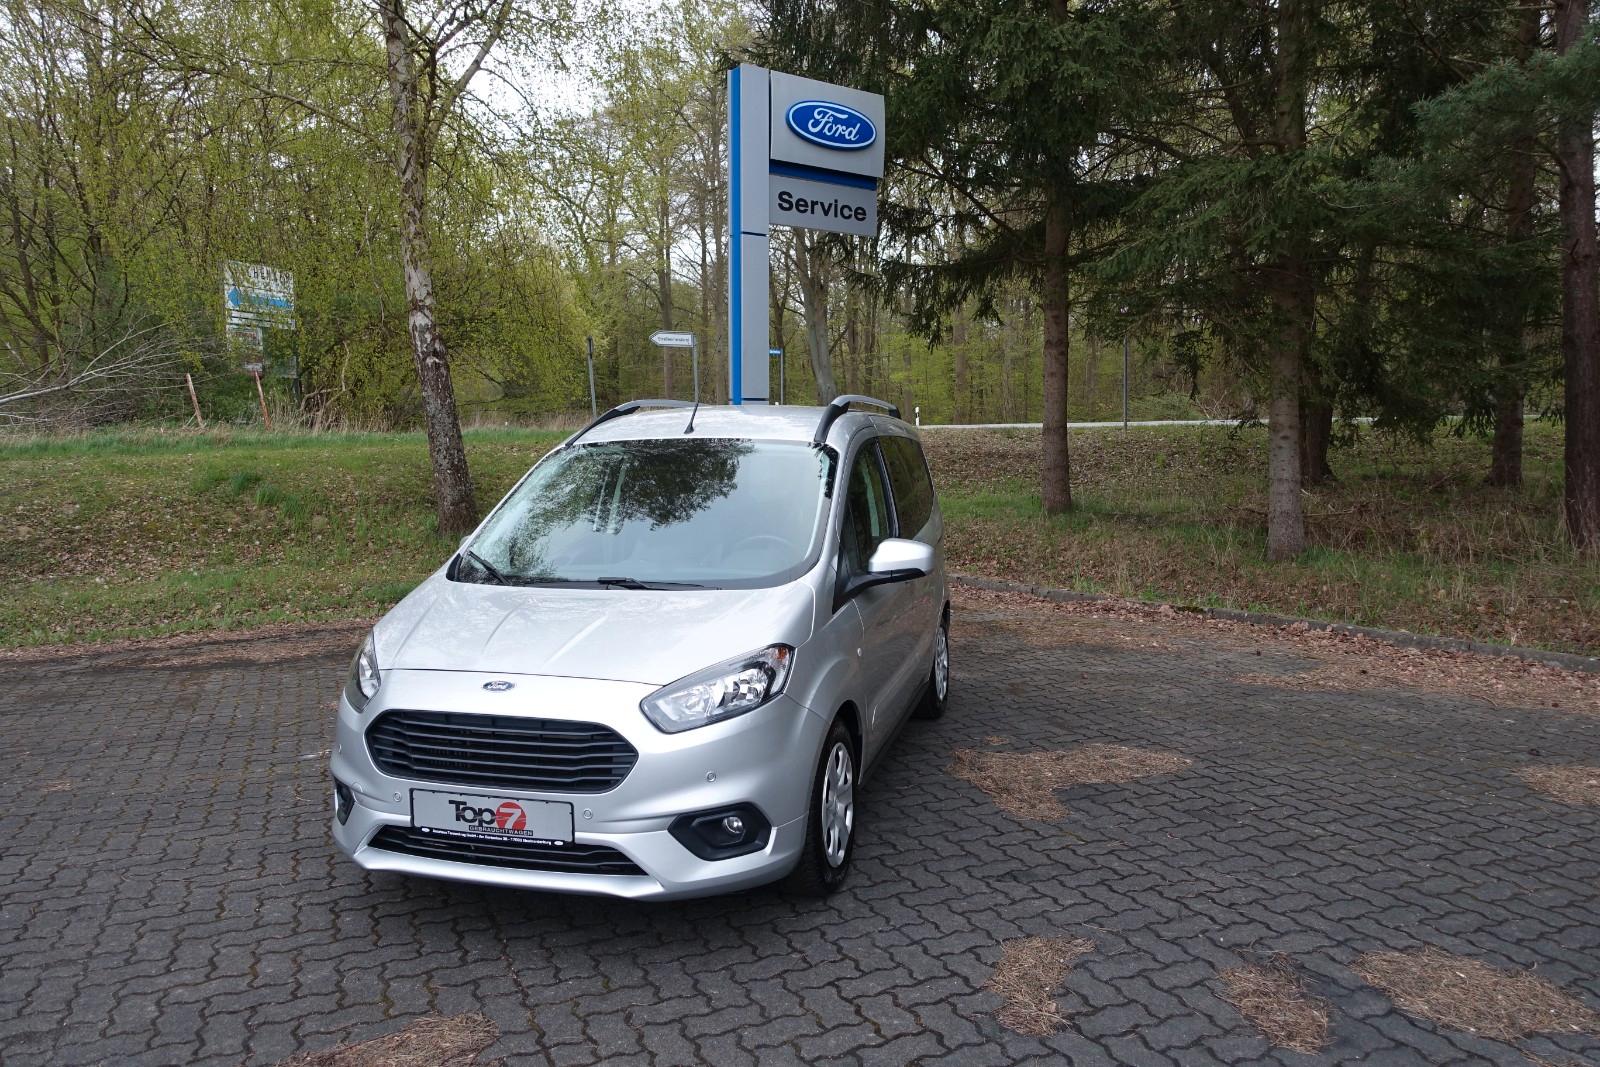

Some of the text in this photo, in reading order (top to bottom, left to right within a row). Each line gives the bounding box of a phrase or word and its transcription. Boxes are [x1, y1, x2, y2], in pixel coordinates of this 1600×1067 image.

[807, 107, 861, 141] Ford
[777, 190, 867, 222] Service
[469, 825, 533, 836] GEBRAUCHTWAGEN
